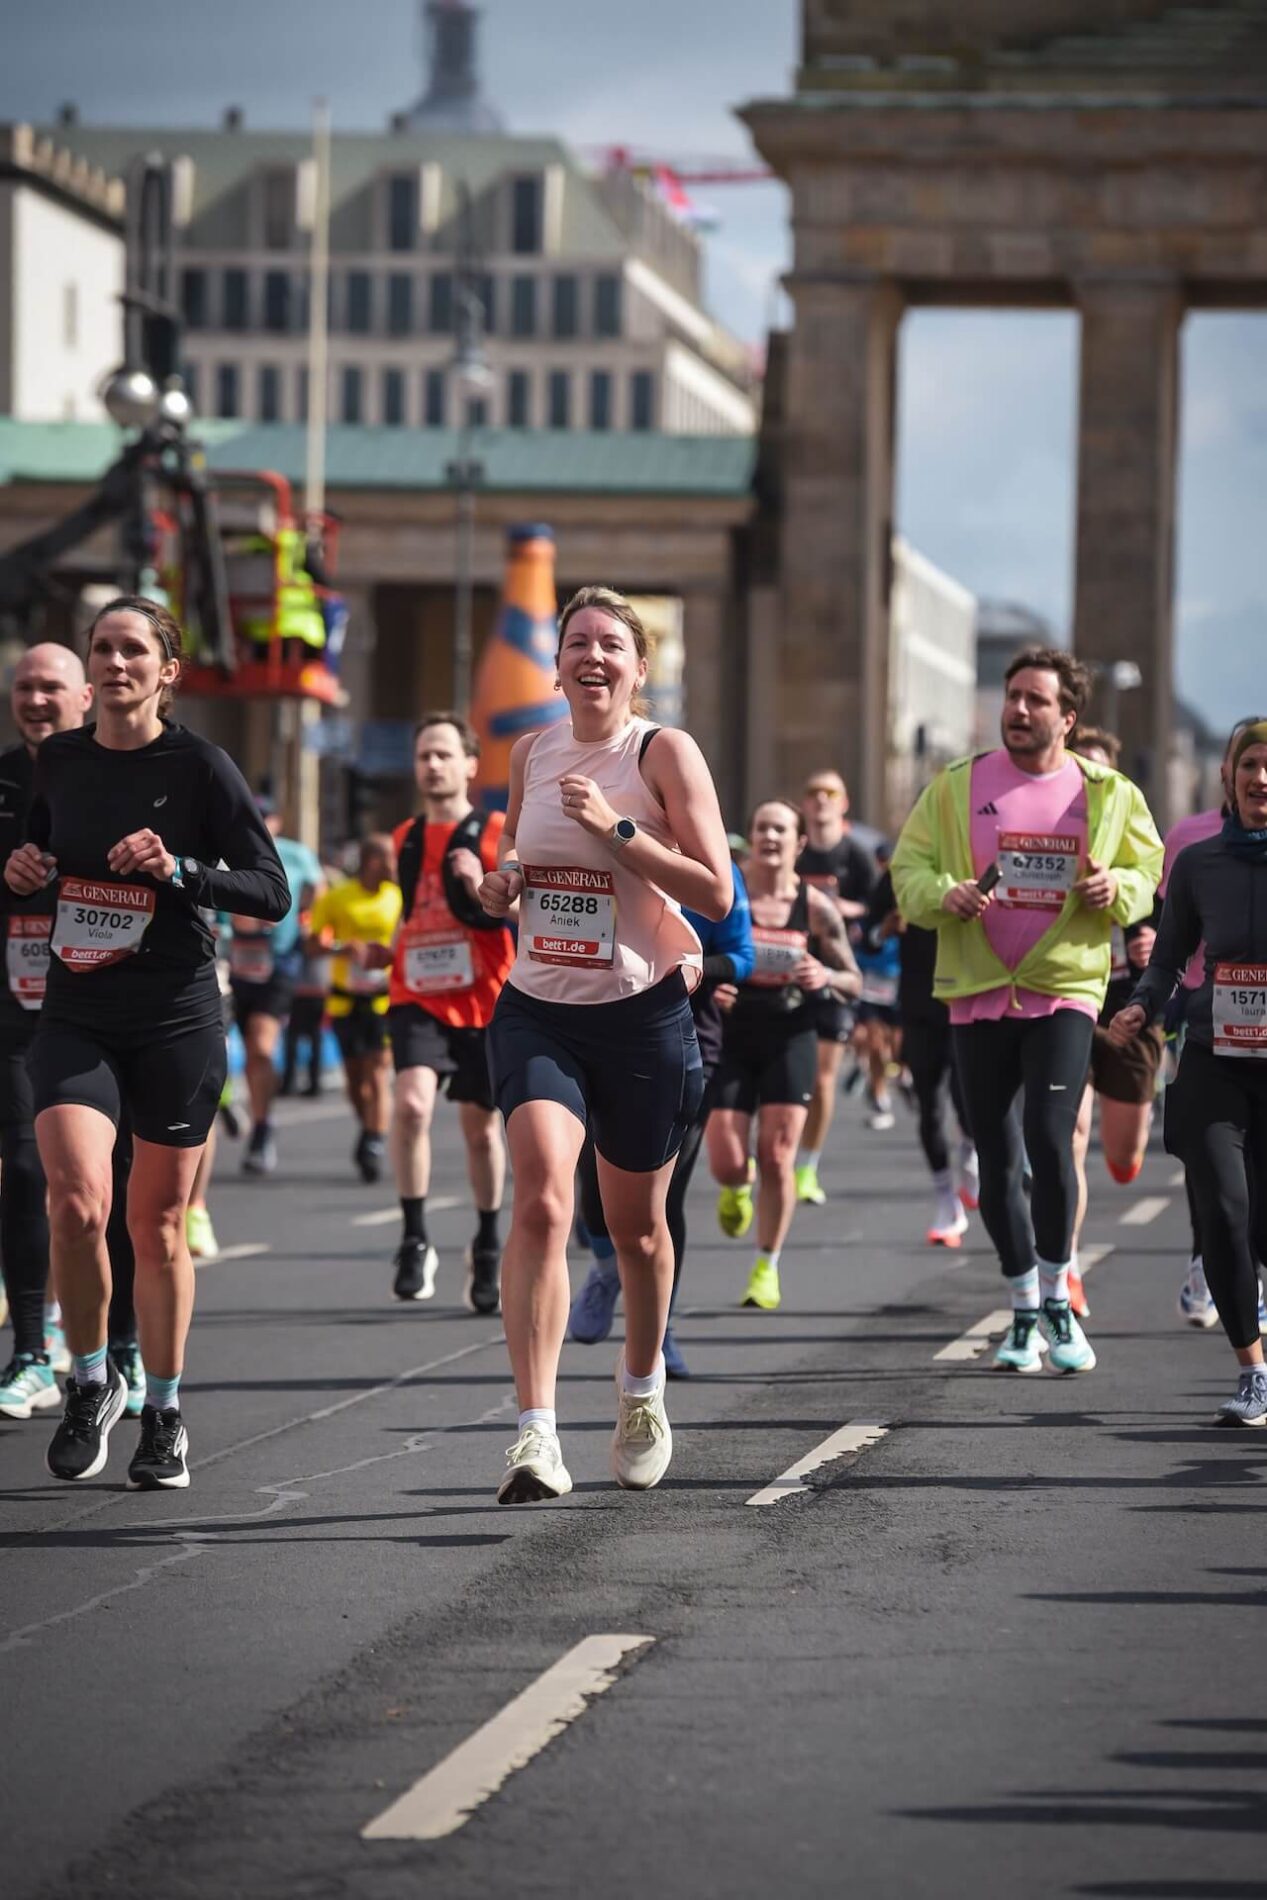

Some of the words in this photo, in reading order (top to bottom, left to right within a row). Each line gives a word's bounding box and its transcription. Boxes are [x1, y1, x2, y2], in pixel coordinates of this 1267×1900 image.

[1013, 855, 1066, 871] 67352
[547, 871, 609, 889] GENERALI
[83, 885, 148, 906] GENERALI
[540, 894, 598, 914] 65288
[74, 907, 133, 930] 30702
[550, 914, 580, 927] Aniek
[88, 927, 113, 940] Viola
[542, 938, 586, 953] bett1.de
[71, 949, 112, 960] bett1.de
[1232, 969, 1267, 982] GENE
